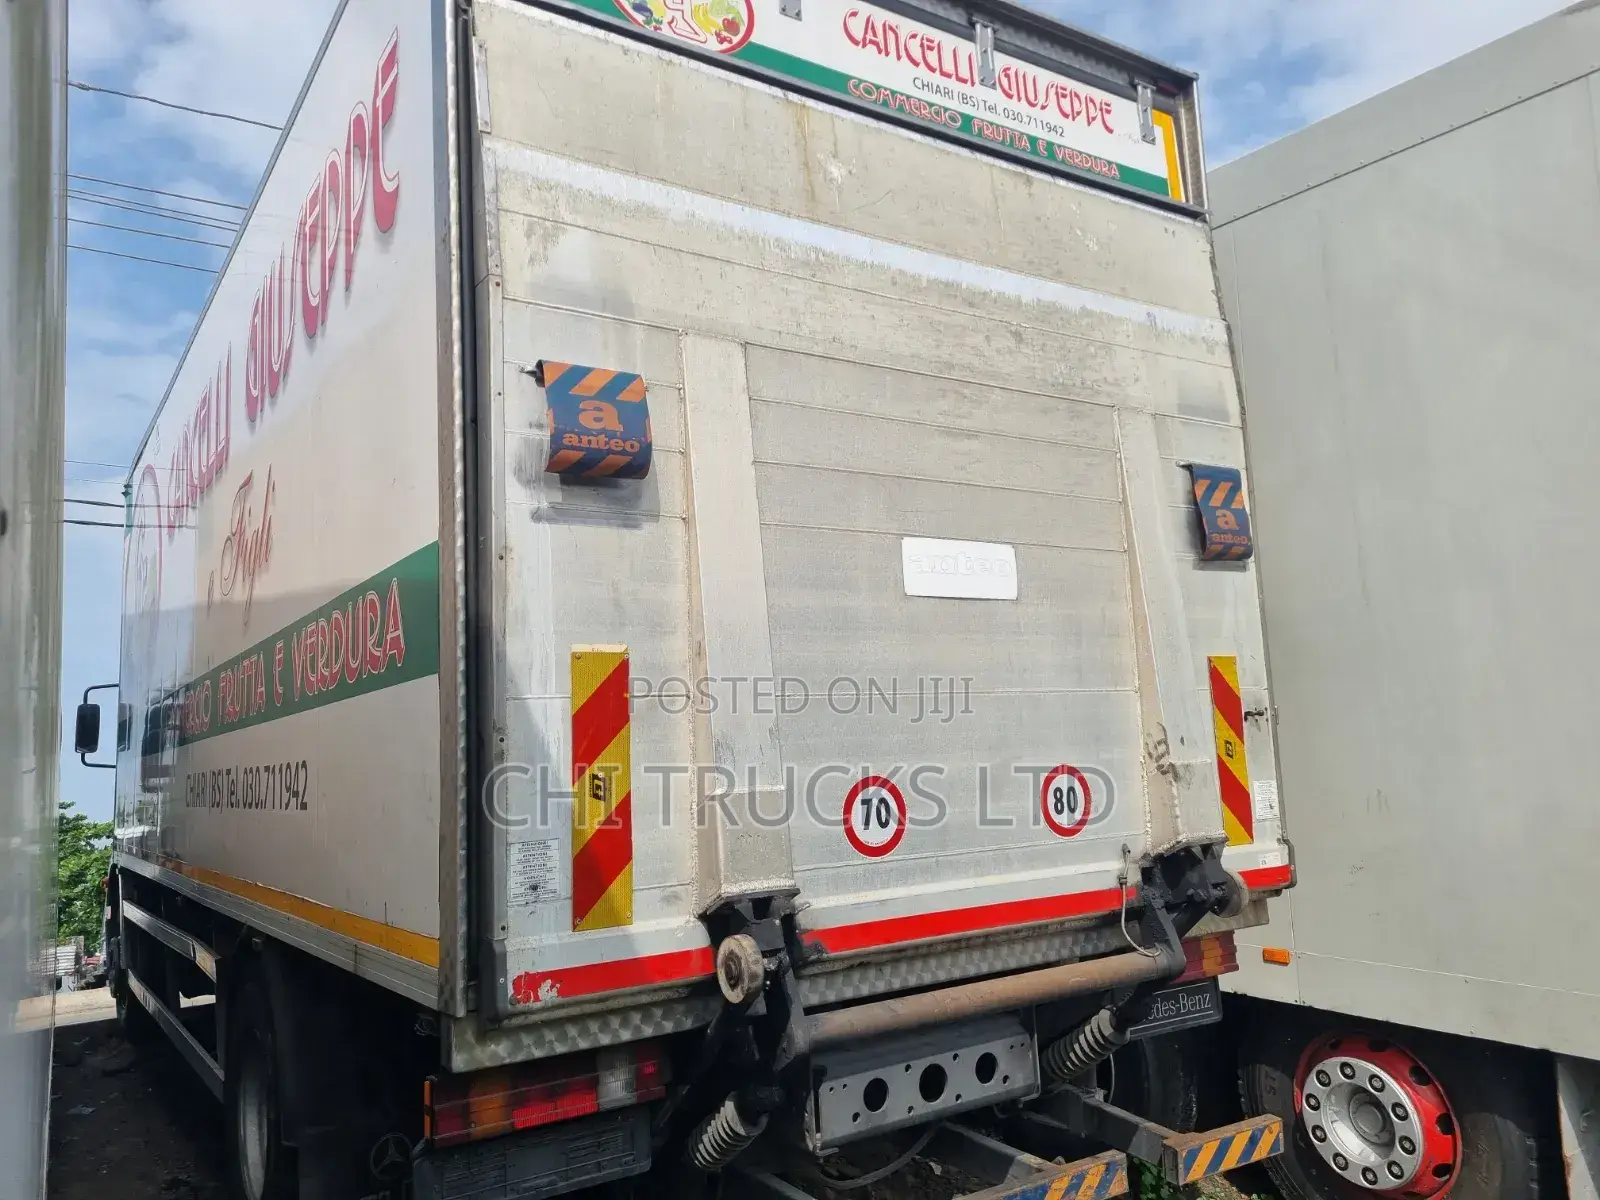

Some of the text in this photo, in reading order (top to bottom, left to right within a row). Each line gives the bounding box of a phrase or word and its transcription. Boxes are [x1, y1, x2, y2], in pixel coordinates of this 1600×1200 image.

[842, 8, 1114, 135] CANCELLI GIUSEPPE
[847, 78, 1121, 180] COMMERCIO FRUTTA E VERDURA
[912, 76, 1066, 138] CHIARI (BS) Tel. 030.711942
[245, 25, 400, 422] GIUSEPPE
[562, 433, 640, 453] anteo
[1211, 533, 1248, 544] anteo
[217, 650, 267, 726] FRUTTA
[273, 640, 284, 707] E
[292, 576, 406, 702] VERDURA
[185, 759, 308, 815] CHIARI (BS) Tel. 030.711942
[860, 797, 891, 831] 70
[1053, 786, 1079, 815] 80
